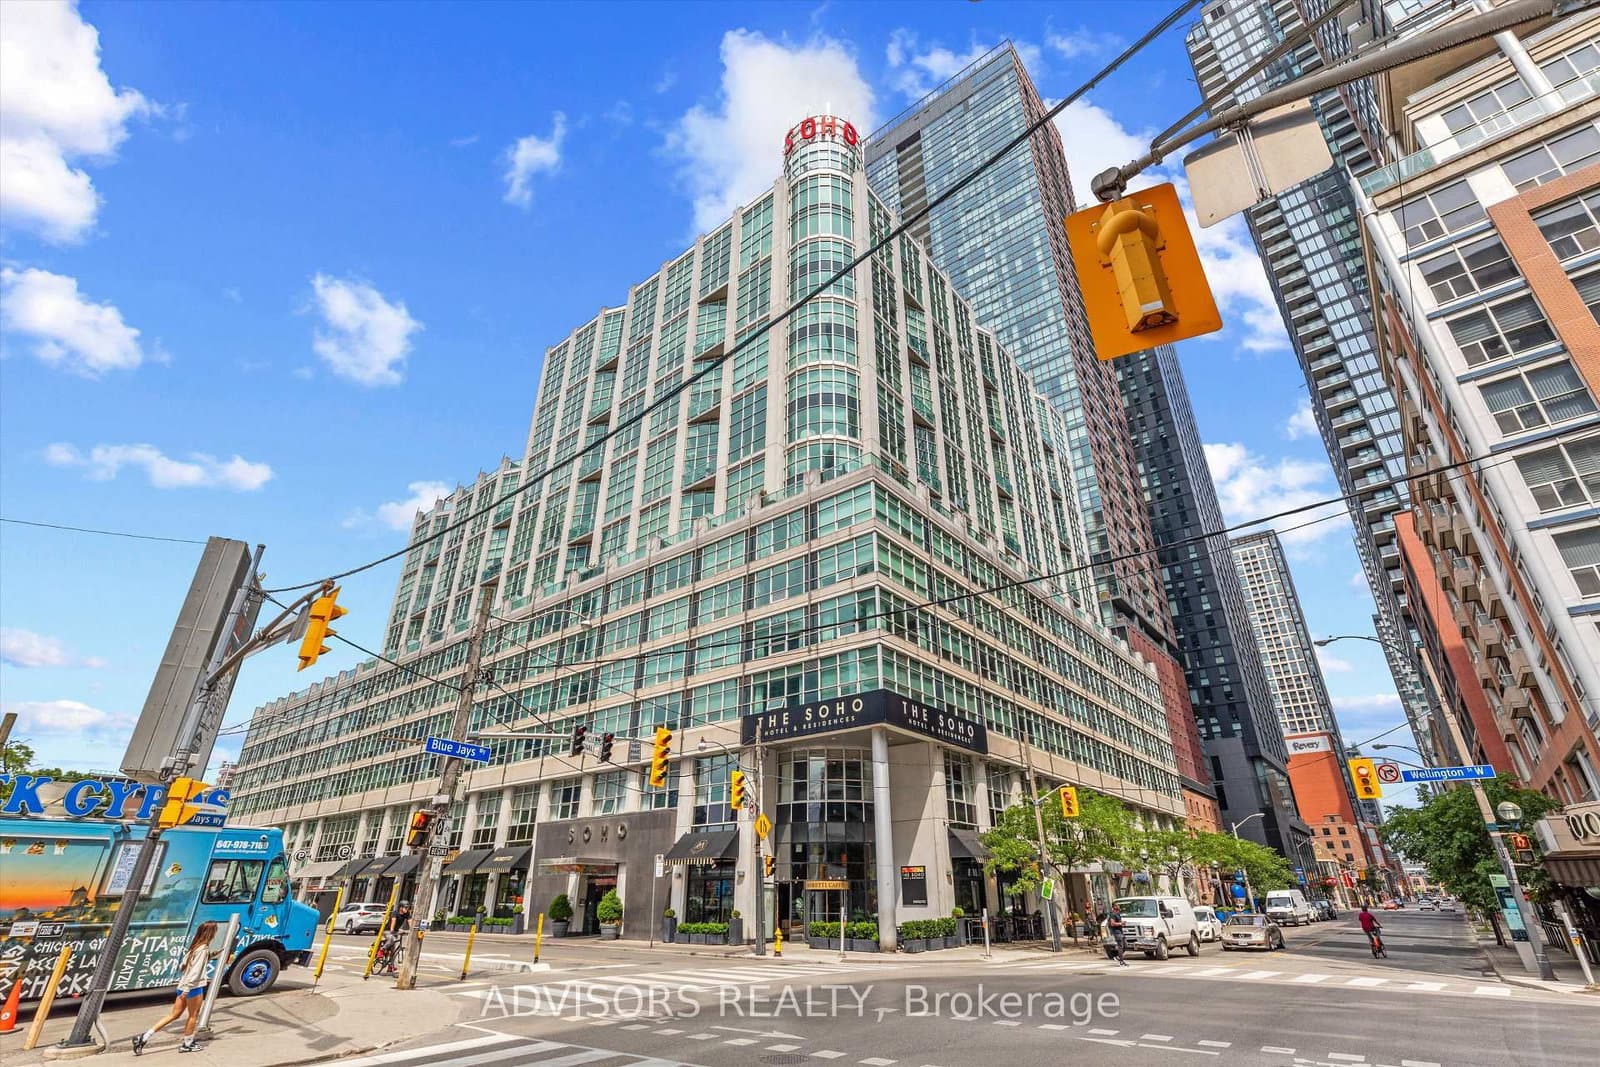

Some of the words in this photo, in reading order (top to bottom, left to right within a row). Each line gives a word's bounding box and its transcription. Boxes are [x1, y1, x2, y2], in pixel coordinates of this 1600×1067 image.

[784, 115, 857, 155] SOHO
[758, 712, 789, 729] THE
[805, 698, 863, 721] SOHO
[902, 701, 928, 721] THE
[939, 714, 974, 737] SOHO
[764, 728, 789, 736] HOTEL
[802, 716, 856, 729] RESIDENCES
[908, 718, 928, 730] HOTEL
[431, 740, 453, 752] Blue
[456, 744, 476, 758] Jays
[1410, 768, 1465, 779] Wellington
[1474, 767, 1484, 776] W
[0, 774, 53, 814] K
[64, 779, 230, 820] GYRS
[191, 815, 210, 825] Jays
[568, 822, 628, 845] SOHO
[33, 940, 85, 953] CHICKEN
[130, 936, 169, 953] PITA
